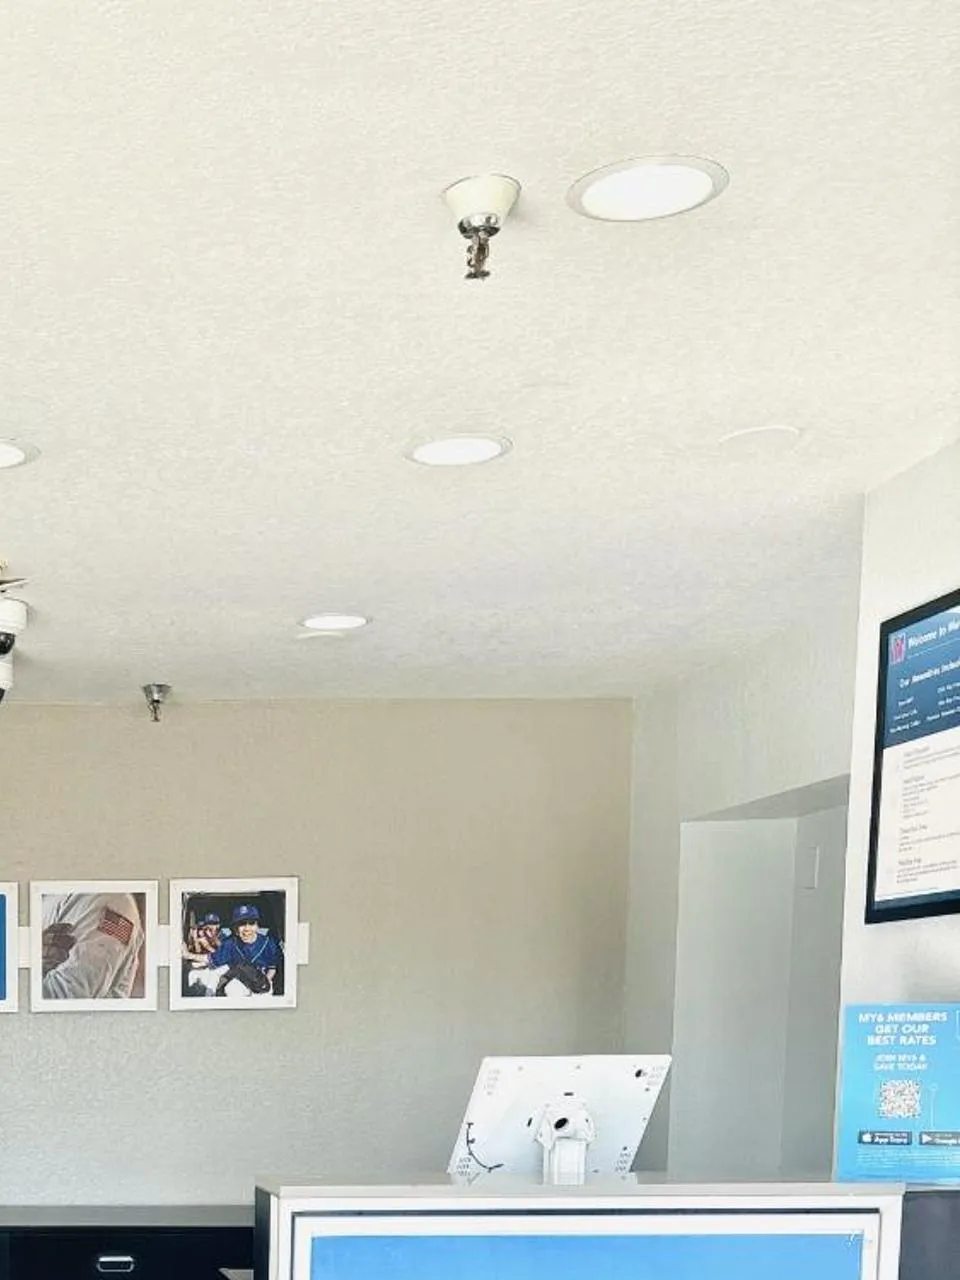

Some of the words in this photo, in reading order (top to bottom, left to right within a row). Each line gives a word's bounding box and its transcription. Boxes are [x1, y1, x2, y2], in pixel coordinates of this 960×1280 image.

[858, 1013, 883, 1023] MY6
[887, 1012, 948, 1022] MEMBERS
[875, 1024, 898, 1034] GET
[901, 1024, 930, 1034] OUR
[867, 1035, 896, 1046] BEST
[899, 1035, 937, 1046] RATES
